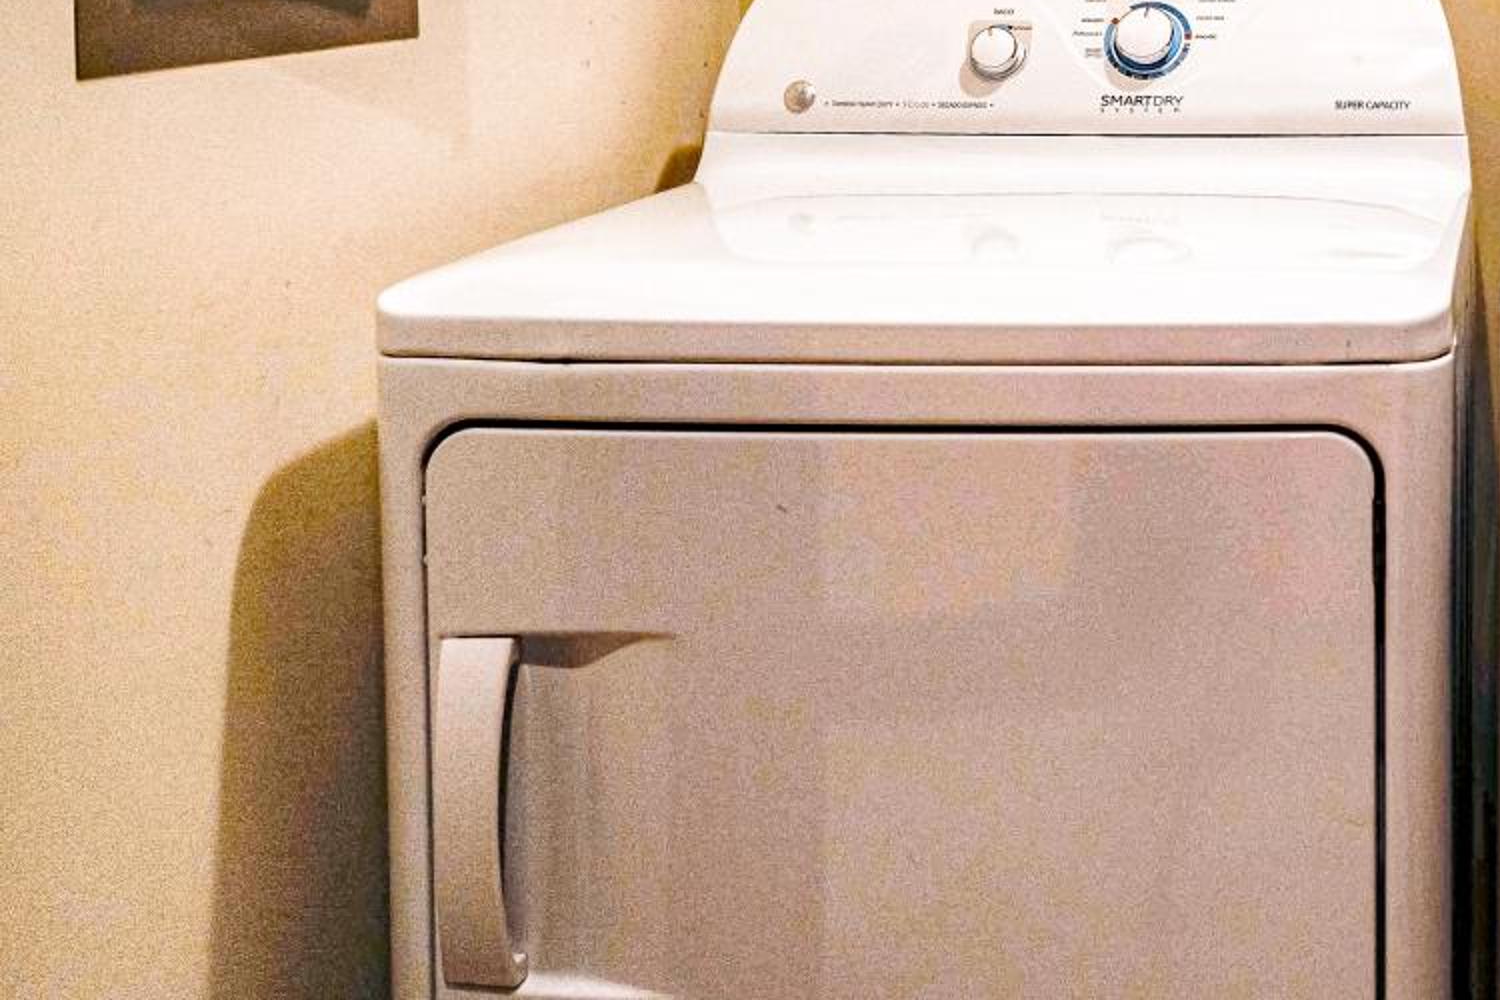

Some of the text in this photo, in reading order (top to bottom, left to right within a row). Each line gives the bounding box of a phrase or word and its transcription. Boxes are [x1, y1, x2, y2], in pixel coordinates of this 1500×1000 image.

[1100, 95, 1184, 107] SMARTDRY
[1334, 100, 1410, 110] SUPER CAPACITY
